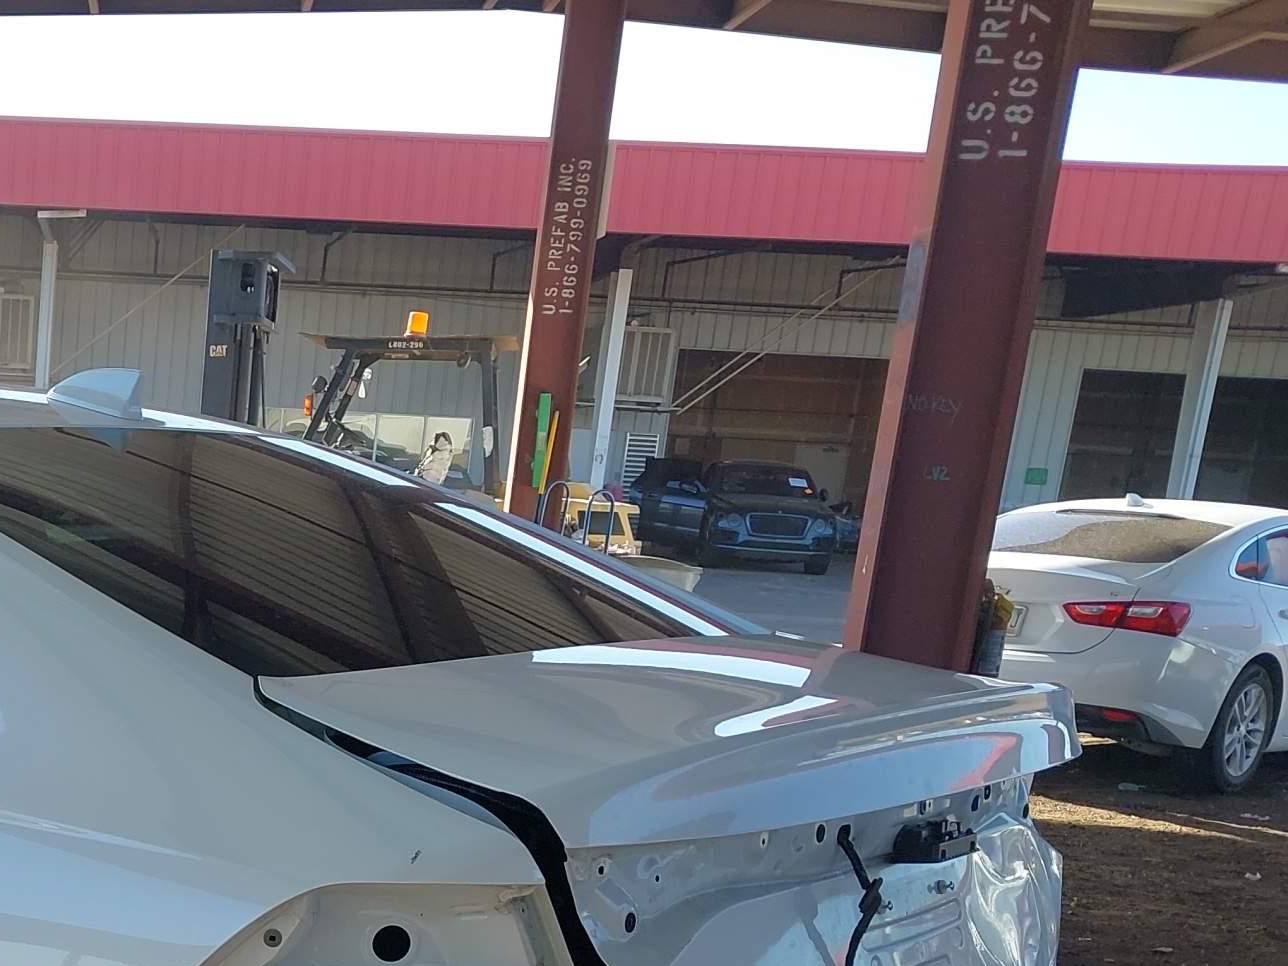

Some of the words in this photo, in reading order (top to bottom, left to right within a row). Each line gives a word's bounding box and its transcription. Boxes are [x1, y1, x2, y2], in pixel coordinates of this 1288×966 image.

[958, 89, 1000, 160] U.S.
[557, 157, 576, 192] INC.
[547, 201, 569, 271] PREFAB
[558, 159, 593, 314] 1-866-799-0969
[541, 281, 560, 315] U.S.
[209, 344, 228, 358] CAT
